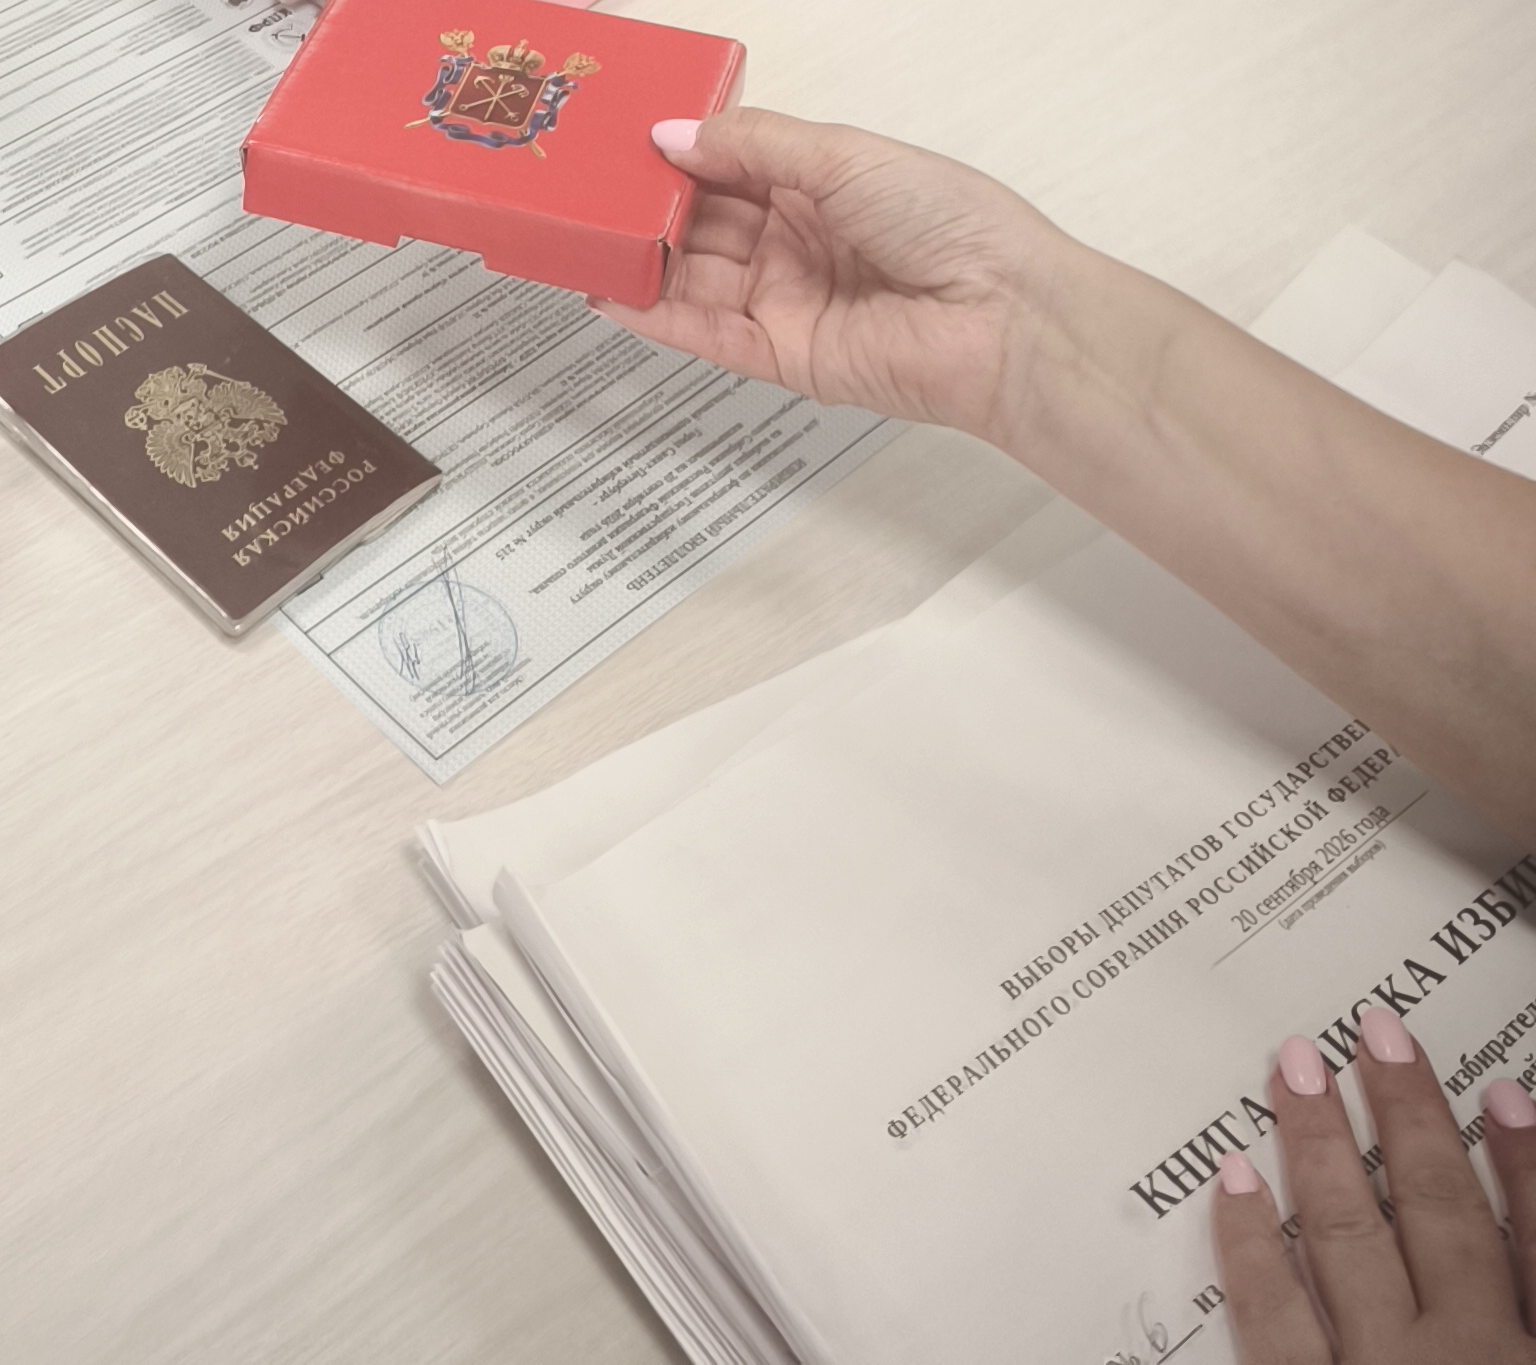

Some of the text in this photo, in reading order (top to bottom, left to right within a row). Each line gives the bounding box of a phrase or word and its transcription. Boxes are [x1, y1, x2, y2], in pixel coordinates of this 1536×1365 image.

[32, 290, 191, 395] ПАСПОРТ
[221, 450, 346, 542] ФЕДЕРАЦИЯ
[232, 459, 377, 567] РОССИЙСКАЯ
[494, 541, 516, 562] 215
[624, 530, 707, 595] БЮЛЛЕТЕНЬ
[998, 920, 1102, 1001] ВЫБОРЫ
[1097, 832, 1225, 932] ДЕПУТАТОВ
[1230, 803, 1392, 934] 20 сентября 2026 года
[886, 744, 1401, 1142] ФЕДЕРАЛЬНОГО СОБРАНИЯ РОССИЙСКОЙ ФЕДЕР
[1129, 1096, 1278, 1219] КНИГА
